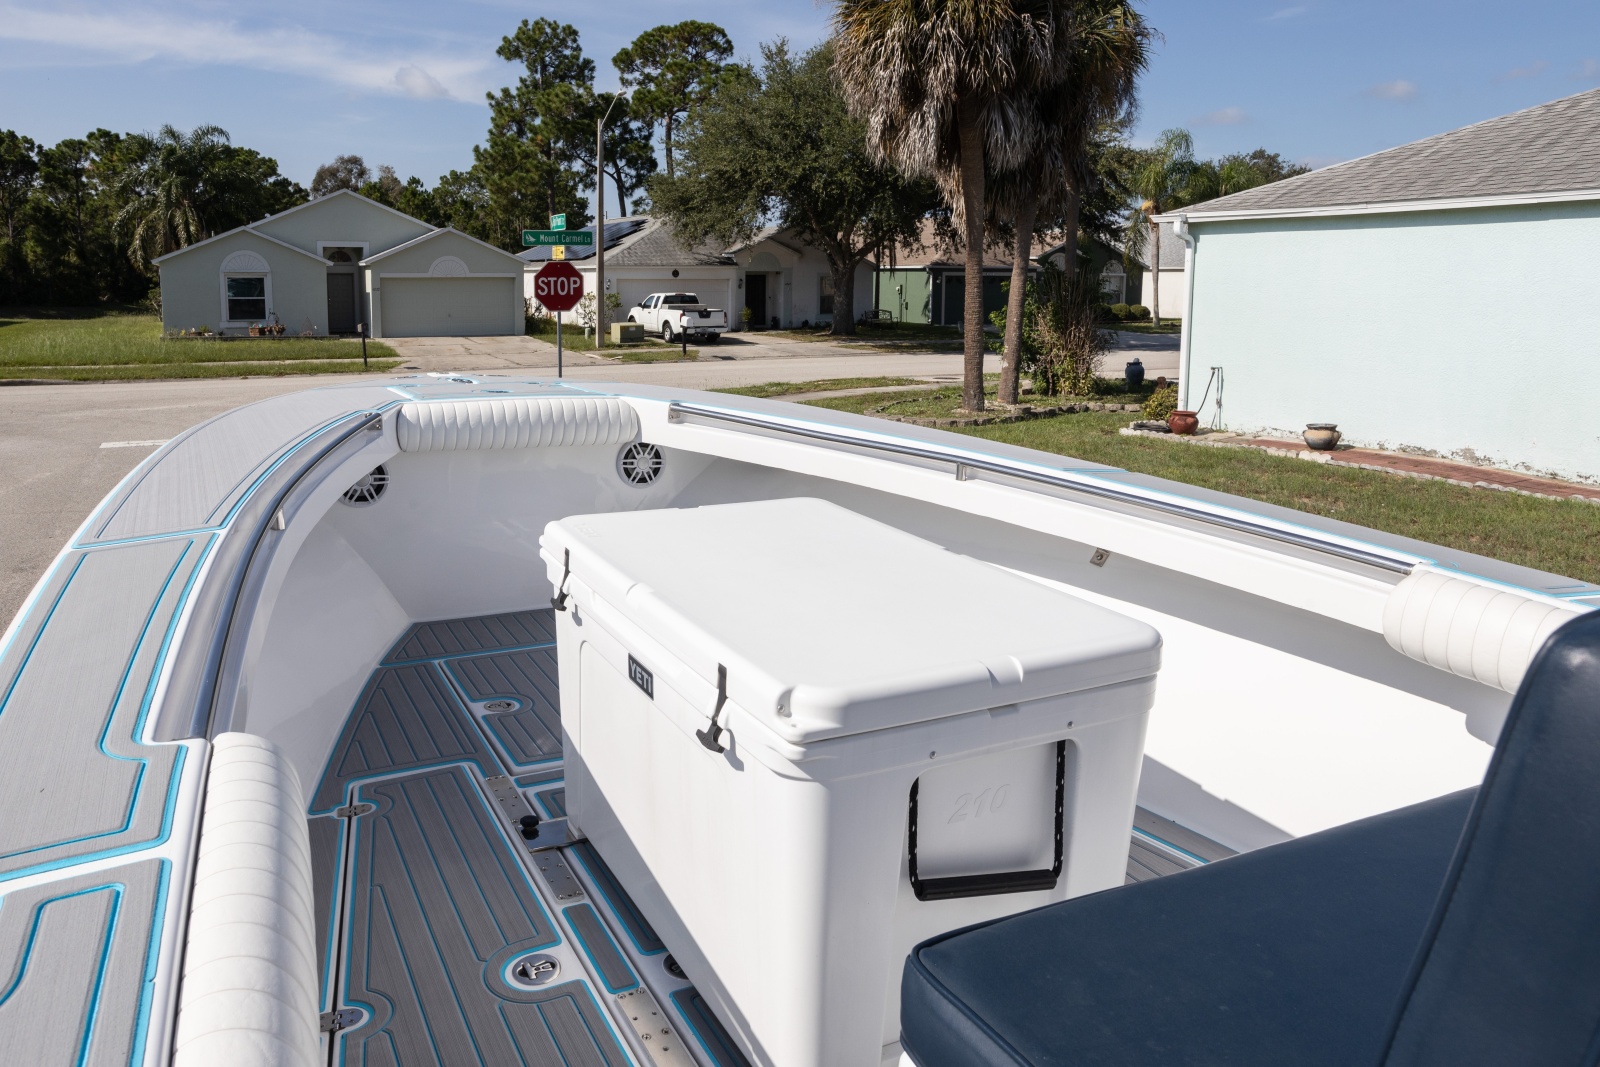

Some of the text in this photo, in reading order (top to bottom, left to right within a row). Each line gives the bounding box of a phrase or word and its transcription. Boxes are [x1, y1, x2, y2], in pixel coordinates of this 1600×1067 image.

[539, 234, 559, 243] Mount
[561, 234, 584, 243] Carmel
[537, 276, 581, 296] STOP
[629, 659, 652, 694] YETI
[946, 783, 1011, 825] 210
